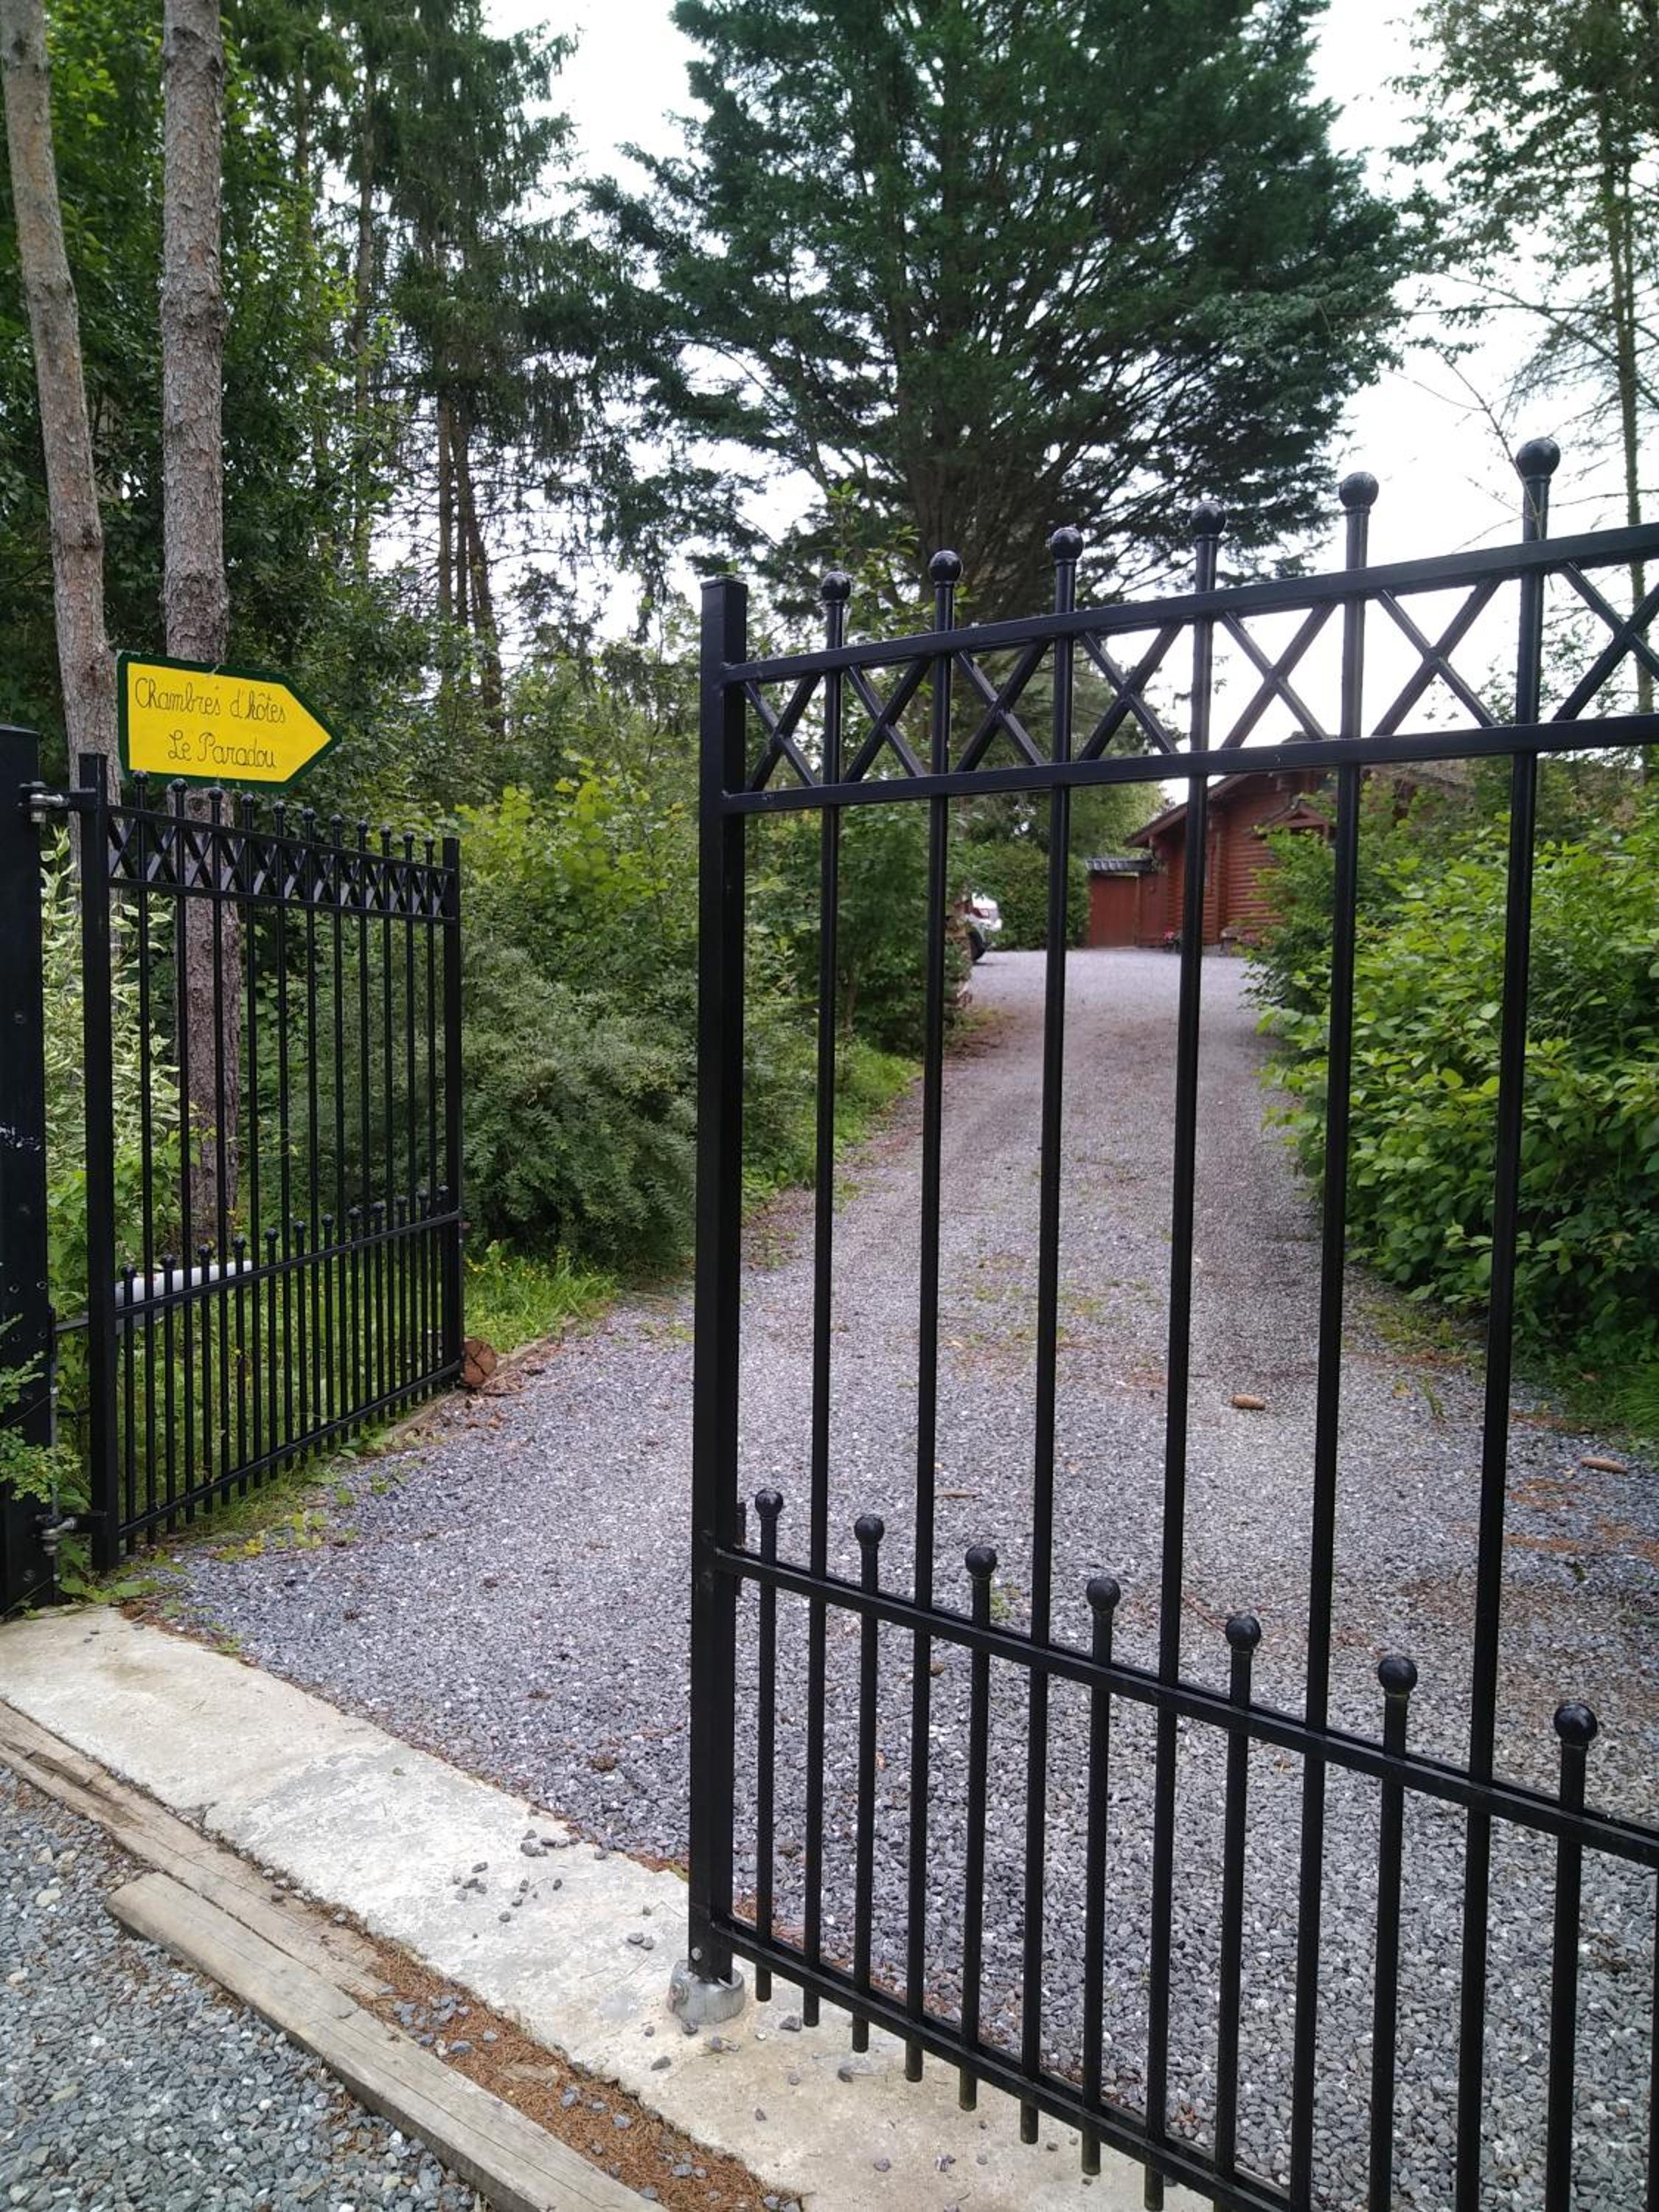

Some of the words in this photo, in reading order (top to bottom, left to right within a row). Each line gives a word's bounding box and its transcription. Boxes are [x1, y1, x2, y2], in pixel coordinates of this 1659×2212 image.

[134, 677, 221, 716] Chambres
[229, 688, 286, 723] d'hôtes
[167, 728, 192, 762] Le
[197, 731, 277, 768] Paradou
